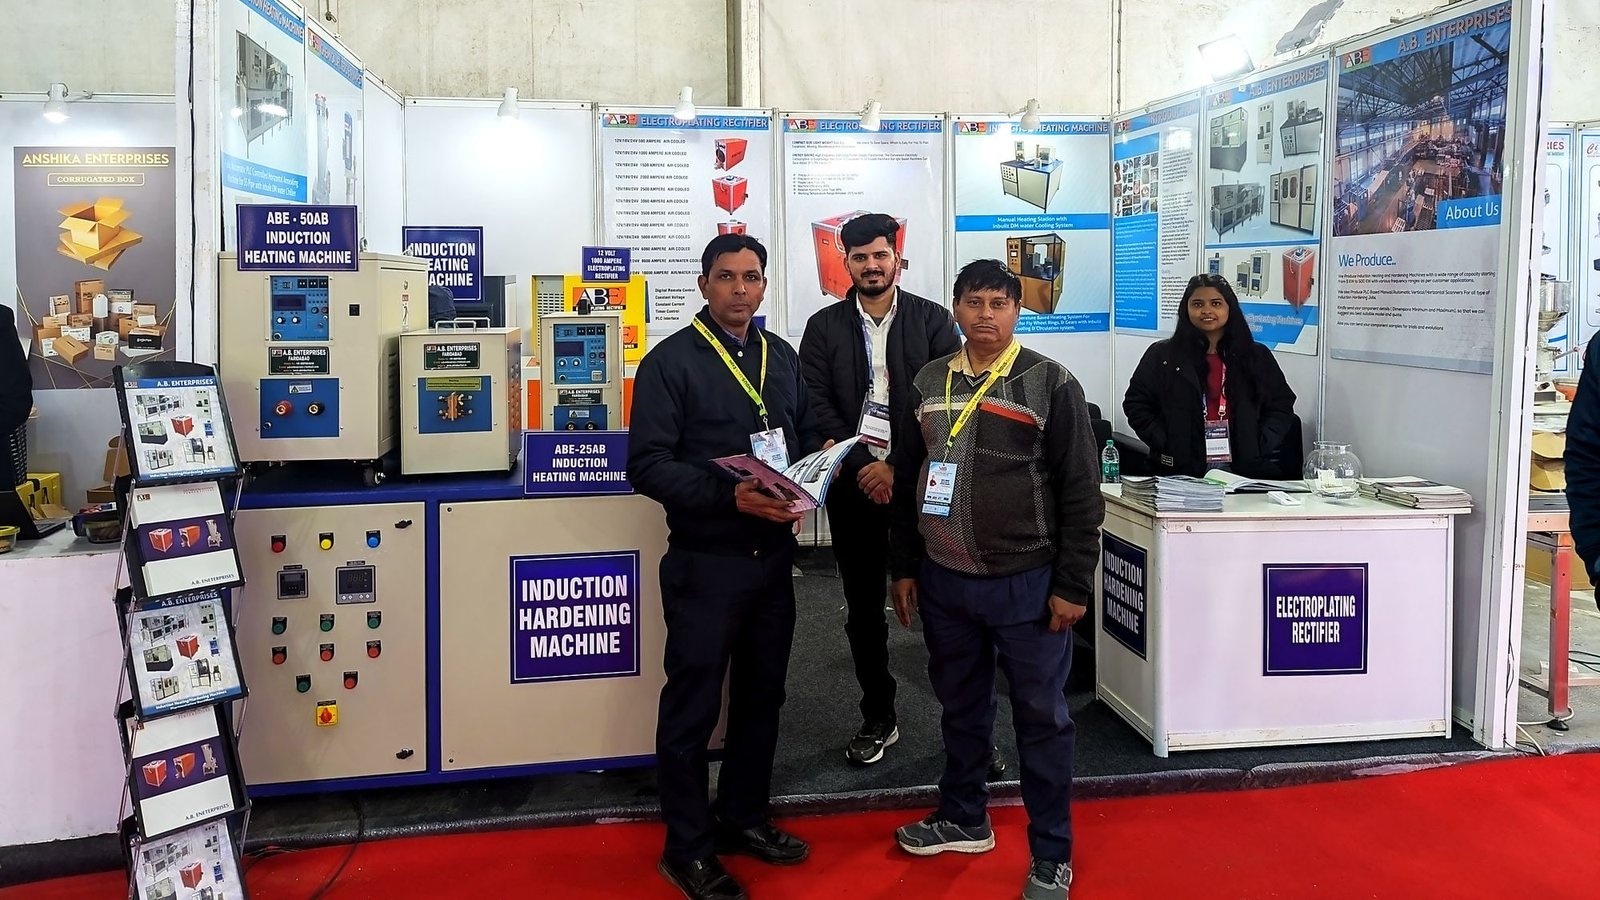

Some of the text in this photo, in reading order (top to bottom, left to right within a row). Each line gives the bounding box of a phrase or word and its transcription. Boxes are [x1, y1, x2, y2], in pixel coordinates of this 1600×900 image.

[1399, 5, 1512, 52] A.B. ENTERPRISES
[1346, 48, 1369, 68] ABE
[1266, 64, 1324, 92] ENTERPRISES
[609, 114, 768, 128] ABE ELECTROPLATING RECTIFIER
[789, 120, 940, 130] ABE ELECTRONG RECTIFIER
[960, 123, 986, 132] ABE
[1072, 124, 1108, 132] MACHINE
[22, 154, 169, 164] ANSHIKA ENTERPRISES
[284, 176, 298, 188] Annealing
[1446, 202, 1499, 220] About Us
[267, 212, 329, 225] ABE 50AB
[266, 231, 330, 244] INDUCTION
[411, 243, 475, 256] INDUCTION
[244, 250, 351, 264] HEATING MACHINE
[1338, 254, 1354, 267] We
[428, 258, 468, 271] EATING
[429, 273, 473, 286] ACHINE
[576, 288, 624, 306] ABE
[555, 444, 606, 454] ABE-25AB
[553, 458, 608, 468] INDUCTION
[533, 472, 626, 482] HEATING MACHINE
[1105, 550, 1142, 587] INDUCTION
[522, 575, 628, 602] INDUCTION
[1104, 572, 1143, 612] HARDENING
[176, 592, 218, 604] ENTERPRISES
[1277, 596, 1355, 618] ELECTROPLATING
[520, 602, 631, 630] HARDENING
[1107, 597, 1139, 634] MACHINE
[1292, 622, 1340, 644] RECTIFIER
[530, 632, 620, 658] MACHINE
